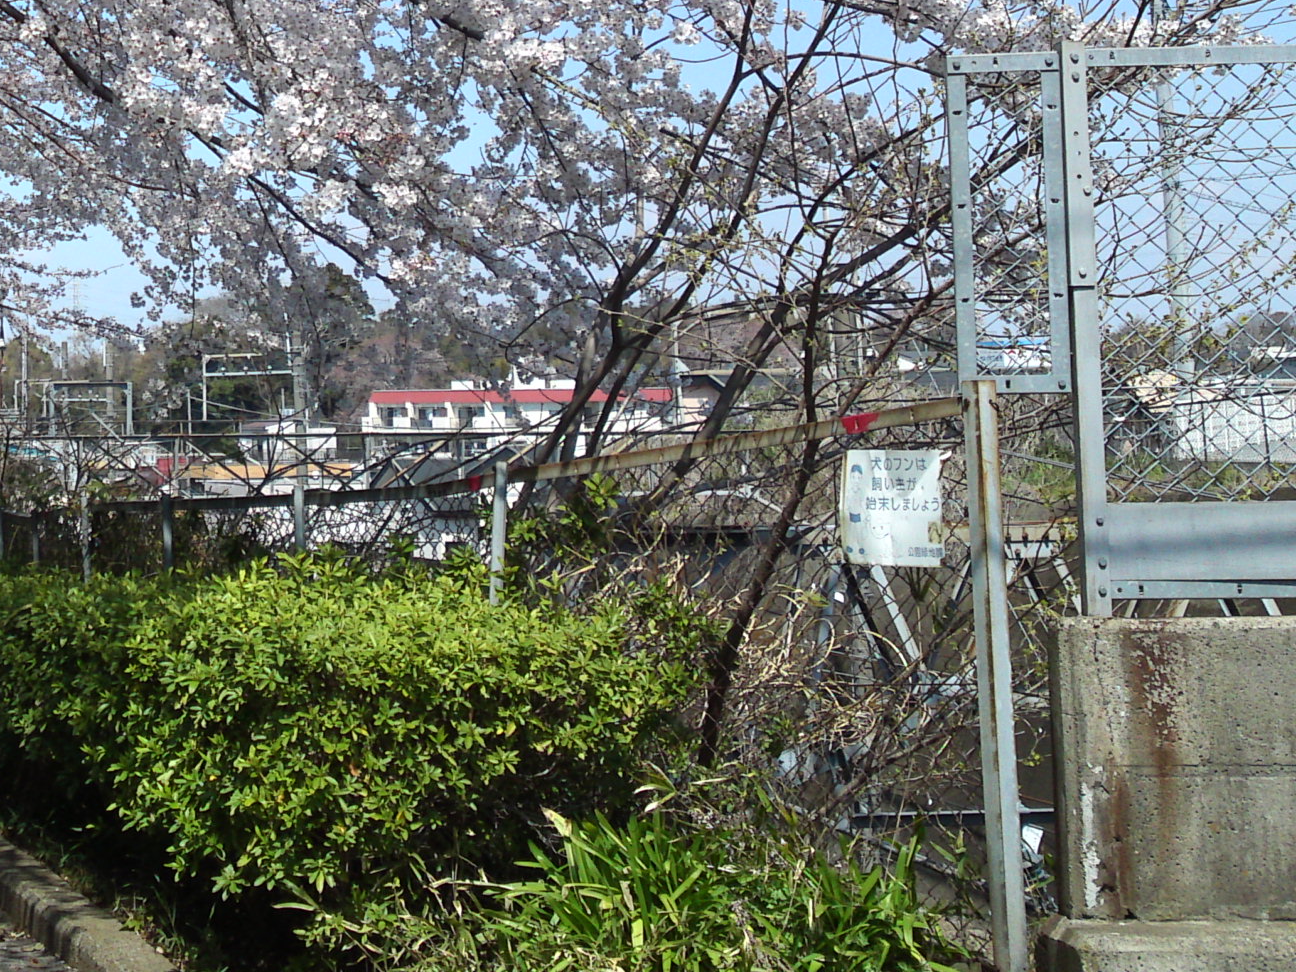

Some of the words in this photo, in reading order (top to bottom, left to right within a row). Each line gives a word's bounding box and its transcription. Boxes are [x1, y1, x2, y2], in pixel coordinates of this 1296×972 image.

[870, 456, 928, 472] 犬のフンは
[865, 496, 941, 512] 始末しましょう
